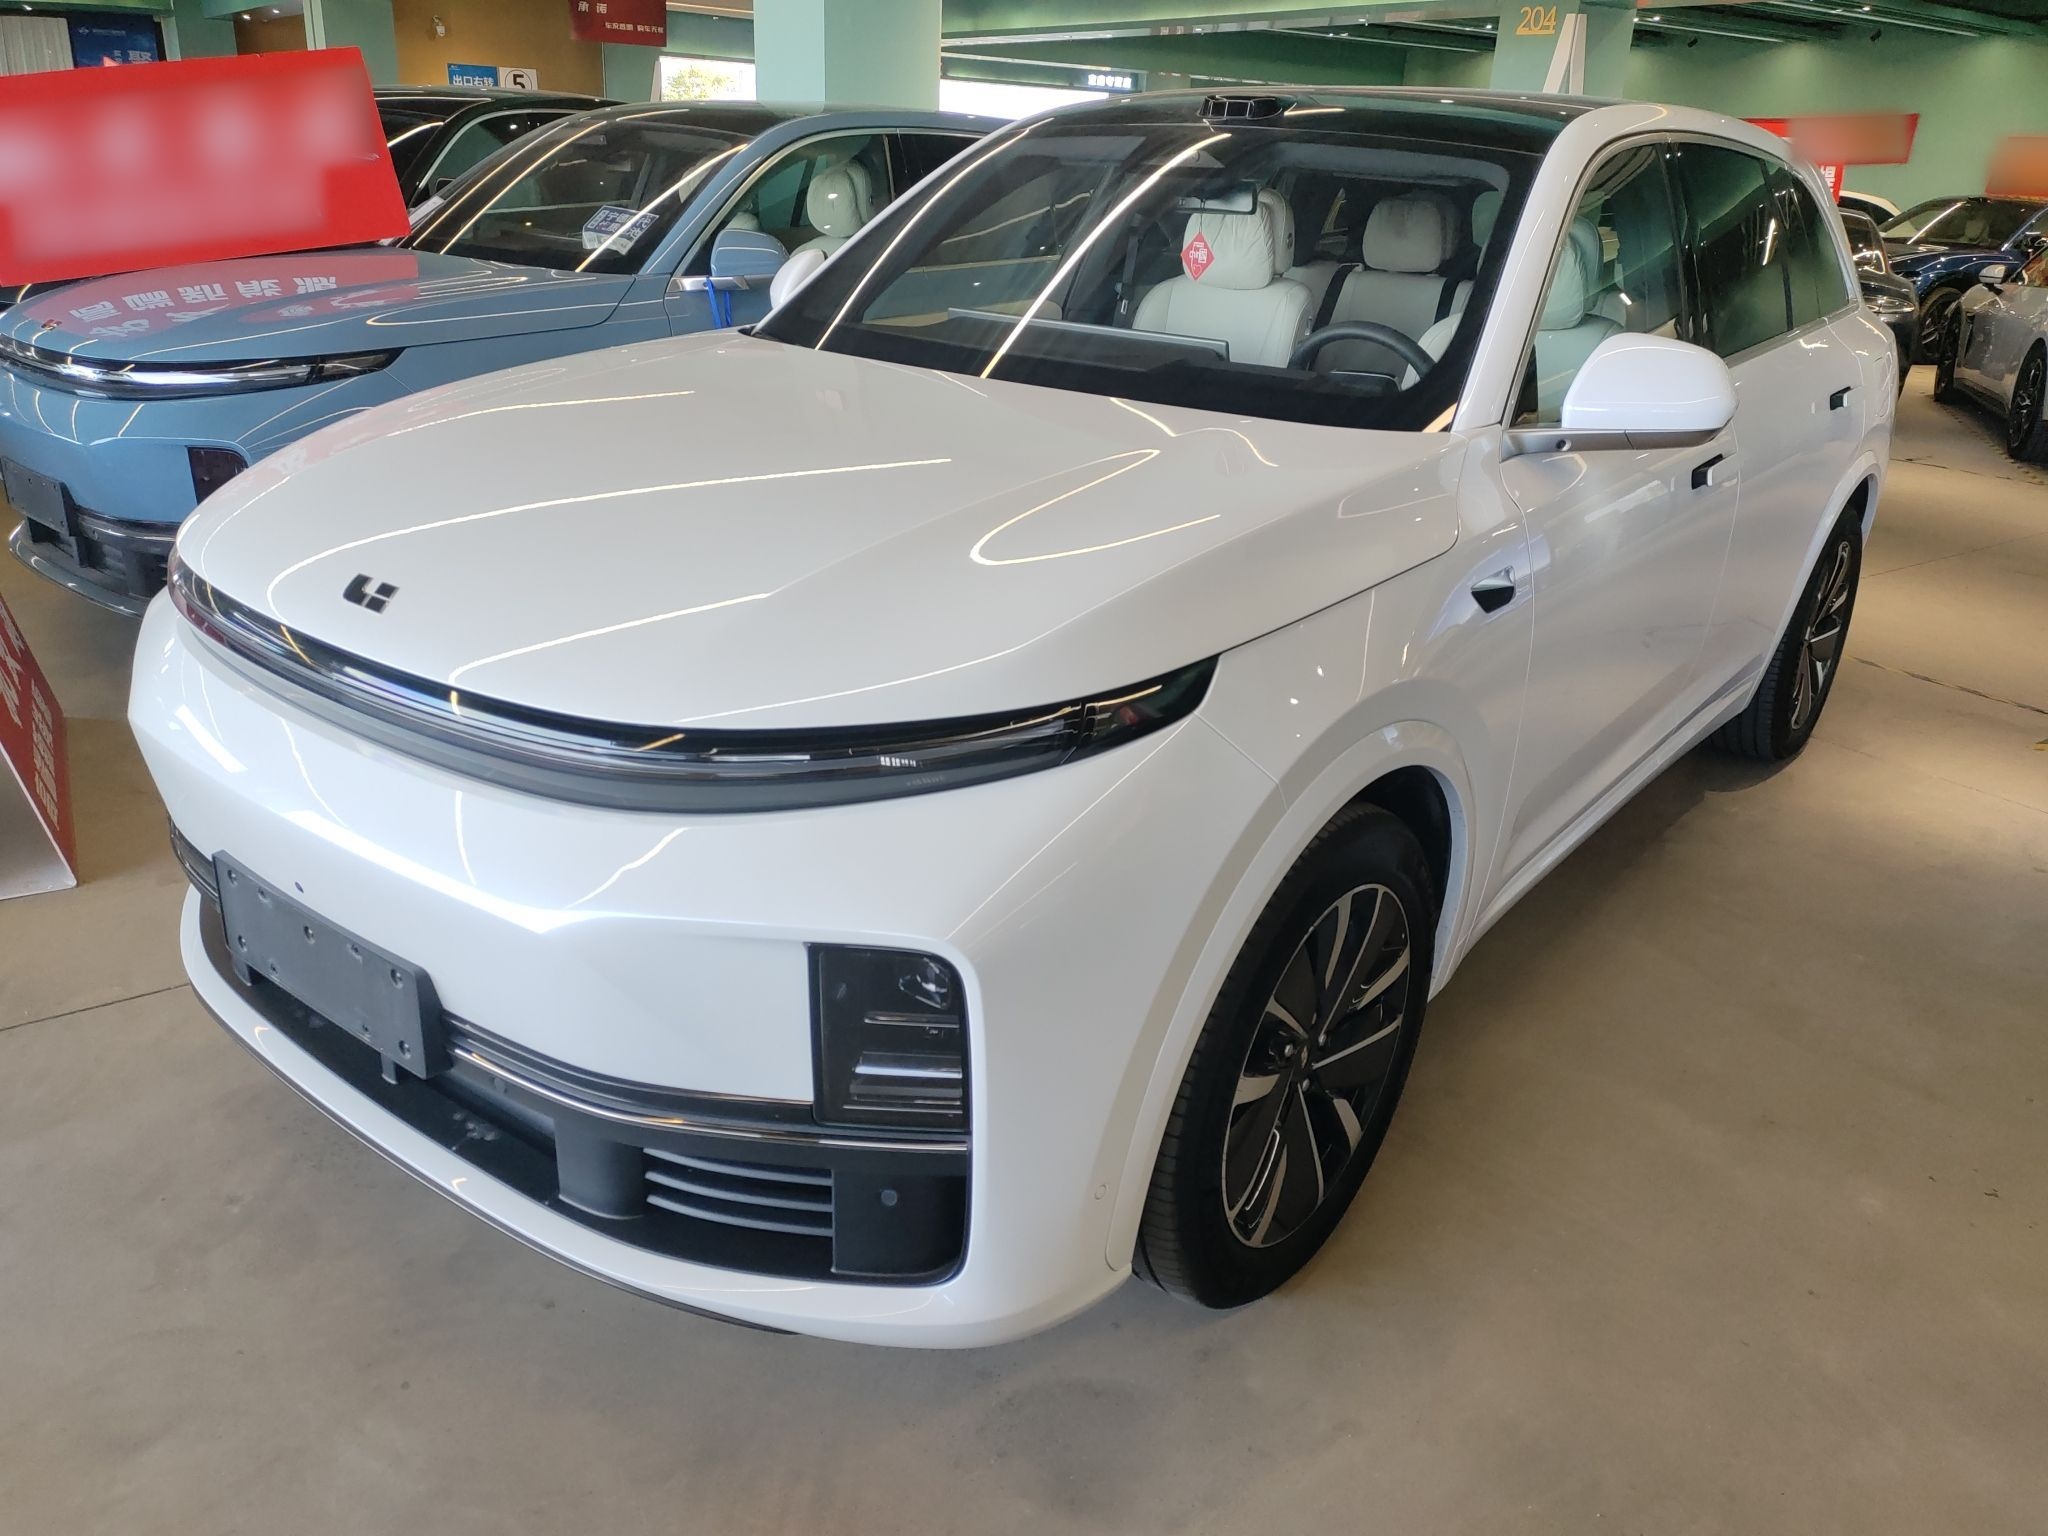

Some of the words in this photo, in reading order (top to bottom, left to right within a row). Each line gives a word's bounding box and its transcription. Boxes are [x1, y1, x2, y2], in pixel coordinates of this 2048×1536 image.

[577, 1, 608, 14] 承诺
[1515, 5, 1557, 31] 204
[452, 74, 495, 87] 出口右转
[512, 73, 526, 89] 5
